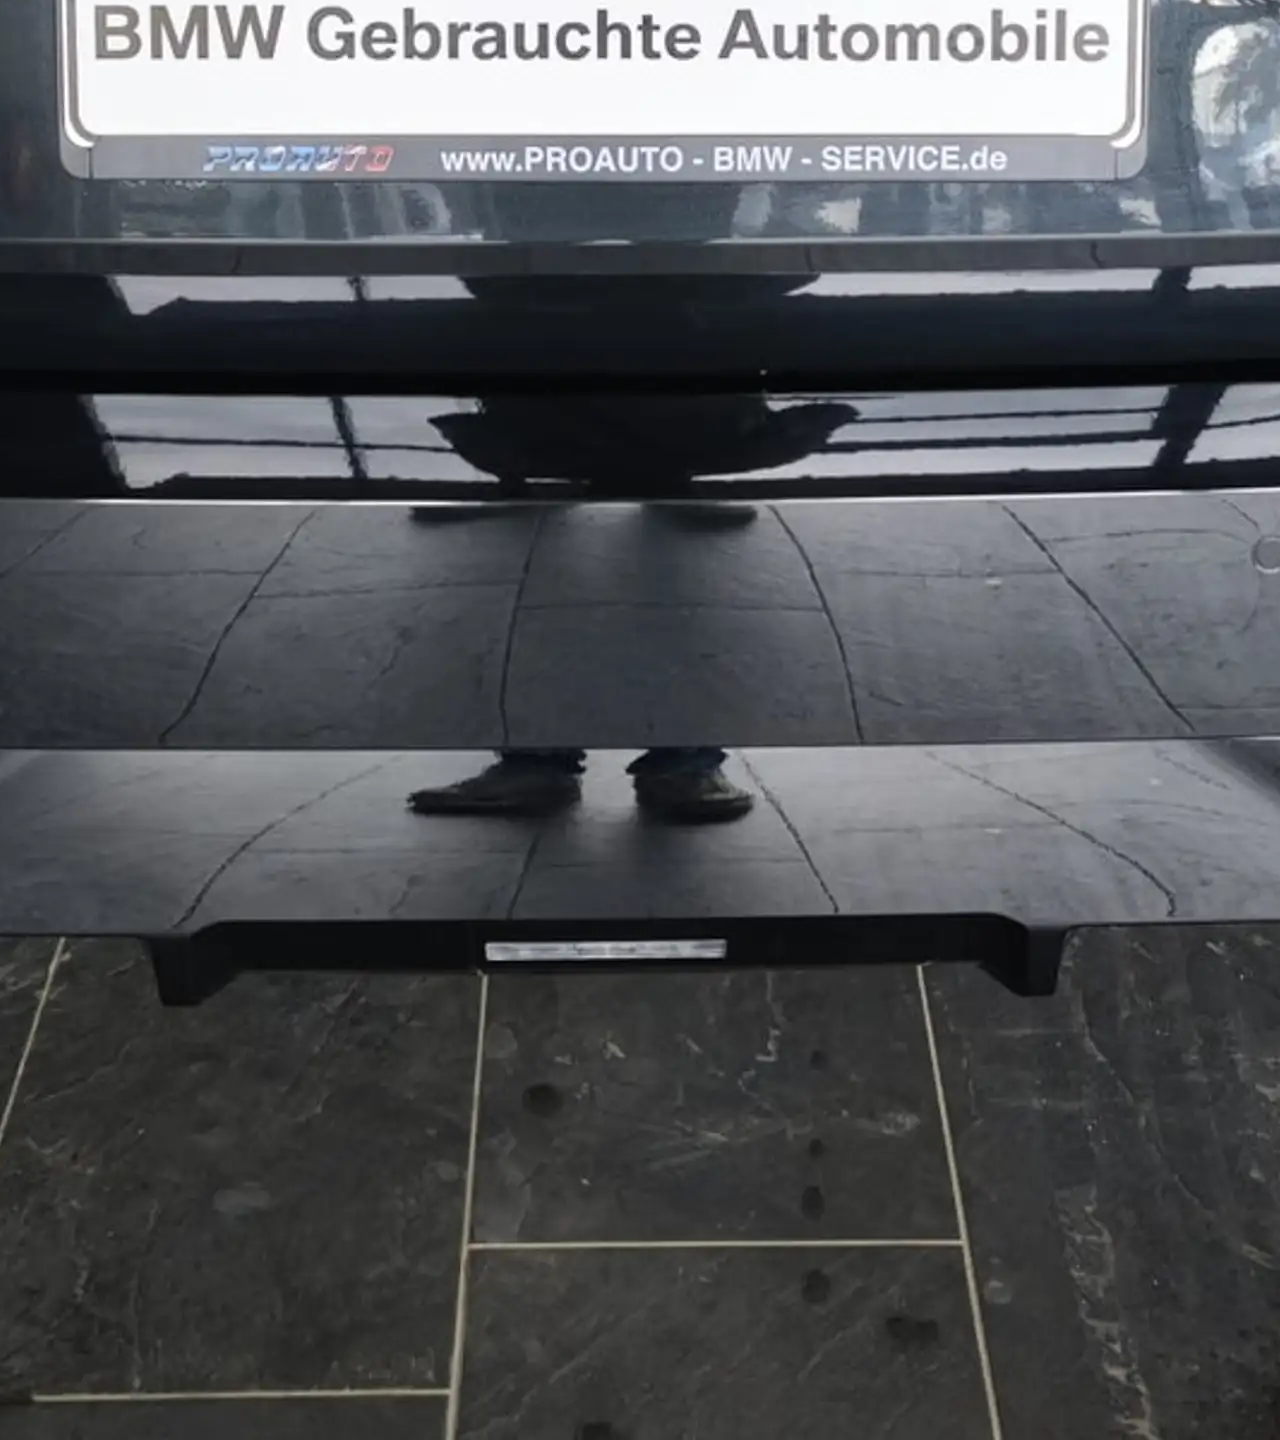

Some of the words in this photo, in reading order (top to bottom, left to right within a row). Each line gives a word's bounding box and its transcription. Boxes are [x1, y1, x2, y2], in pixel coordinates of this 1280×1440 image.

[93, 4, 285, 61] BMW
[306, 6, 702, 61] Gebrauchte
[718, 8, 1110, 62] Automobile
[203, 145, 395, 173] PROAUTO
[440, 146, 683, 173] www.PROAUTO
[713, 146, 793, 173] BMW
[821, 145, 1008, 173] SERVICE.de
